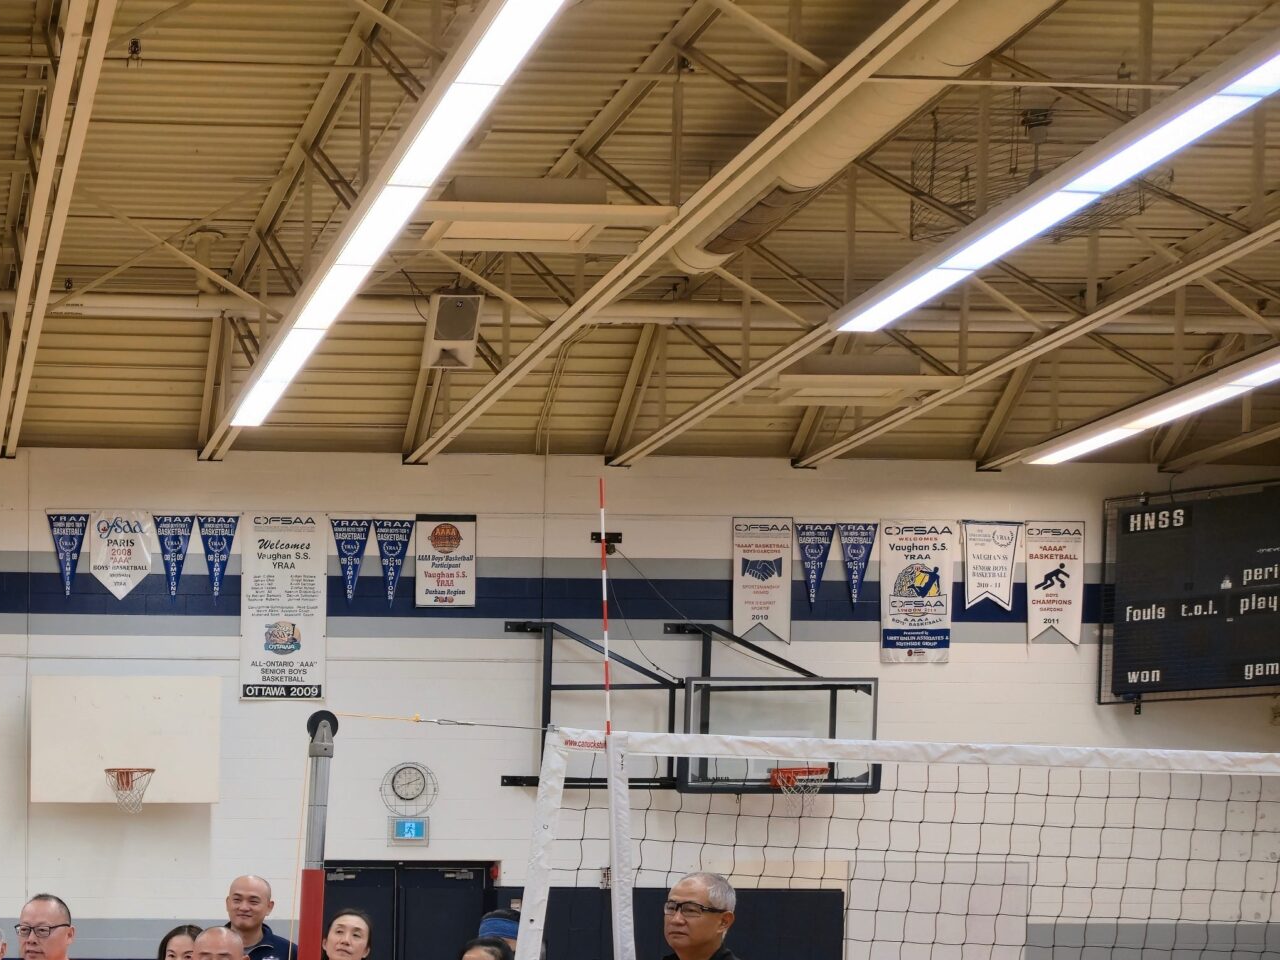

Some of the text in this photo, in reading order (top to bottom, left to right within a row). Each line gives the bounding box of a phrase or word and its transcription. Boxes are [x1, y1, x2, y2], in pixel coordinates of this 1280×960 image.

[254, 517, 316, 525] OFSAA
[1129, 509, 1185, 532] HNSS
[157, 528, 191, 536] BASKETBALL
[201, 528, 235, 536] BASKETBALL
[735, 524, 791, 532] OFSAA
[884, 526, 953, 535] OFSAA
[1027, 528, 1082, 536] OFSAA
[377, 533, 408, 541] BASKETBALL
[107, 539, 135, 547] PARIS
[258, 539, 311, 549] Welcomes
[889, 543, 930, 552] Vaughan
[257, 552, 291, 560] Vaughan
[431, 562, 461, 570] Participant
[424, 571, 455, 579] Vaughan
[1126, 604, 1165, 622] fouls
[1240, 594, 1278, 615] play
[251, 660, 294, 668] ALL-ONTARIO
[1127, 670, 1160, 683] won
[246, 686, 318, 697] OTTAWA 2009
